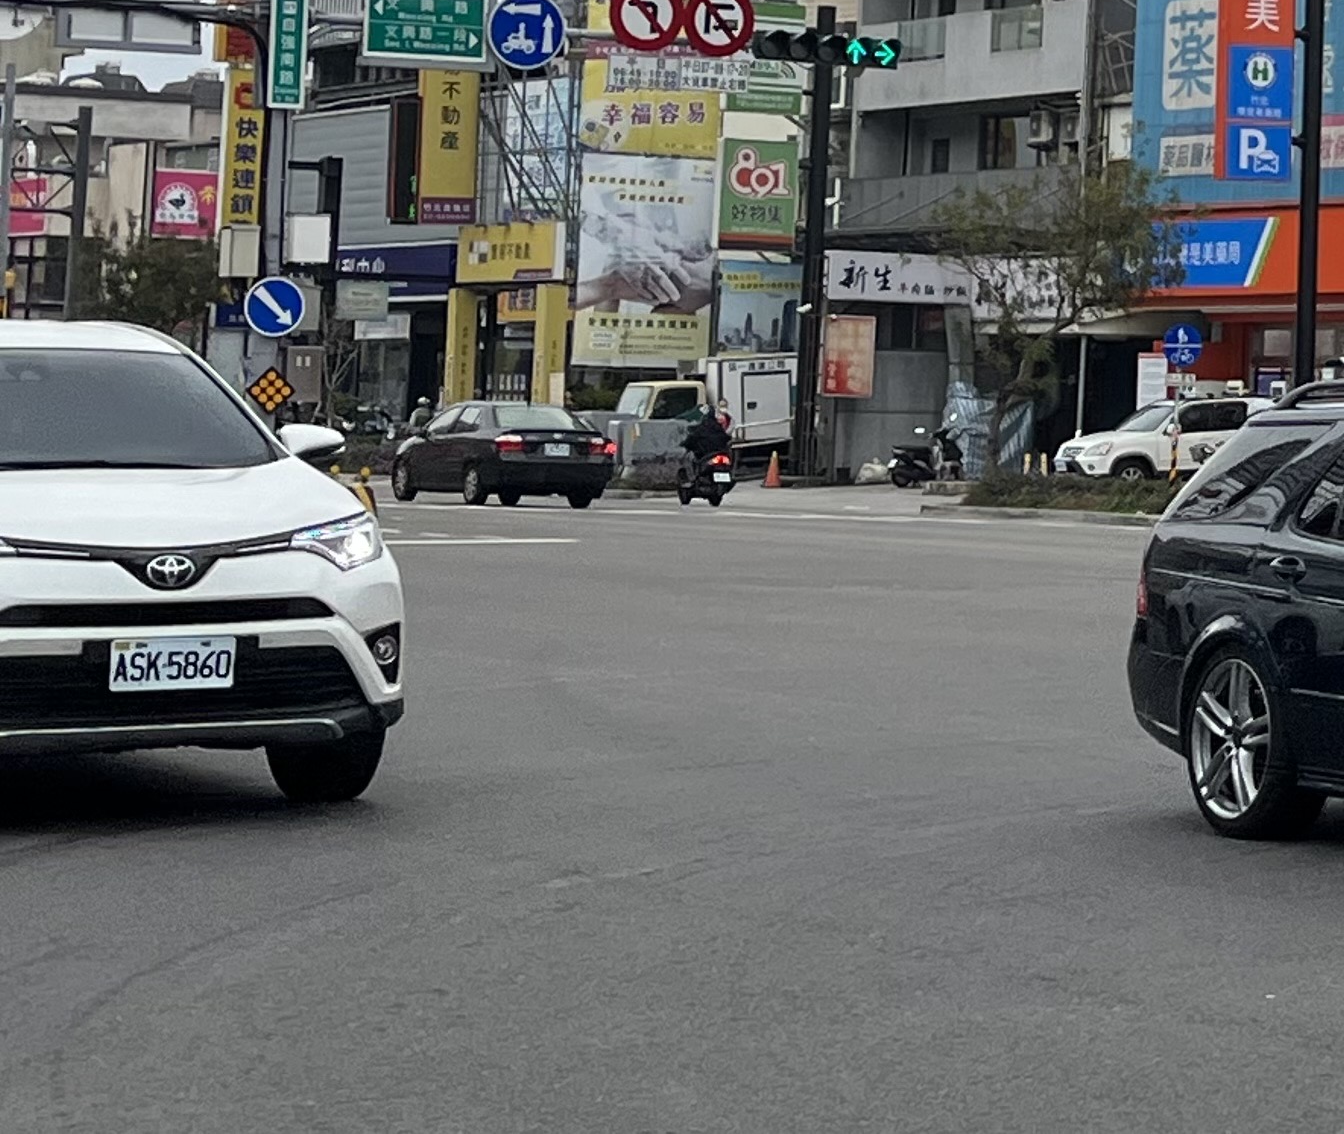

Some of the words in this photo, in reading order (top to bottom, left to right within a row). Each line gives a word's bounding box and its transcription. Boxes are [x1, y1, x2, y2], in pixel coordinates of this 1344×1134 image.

[602, 102, 706, 126] 幸福容易
[229, 117, 259, 225] 快樂連鎖
[838, 259, 892, 293] 新生
